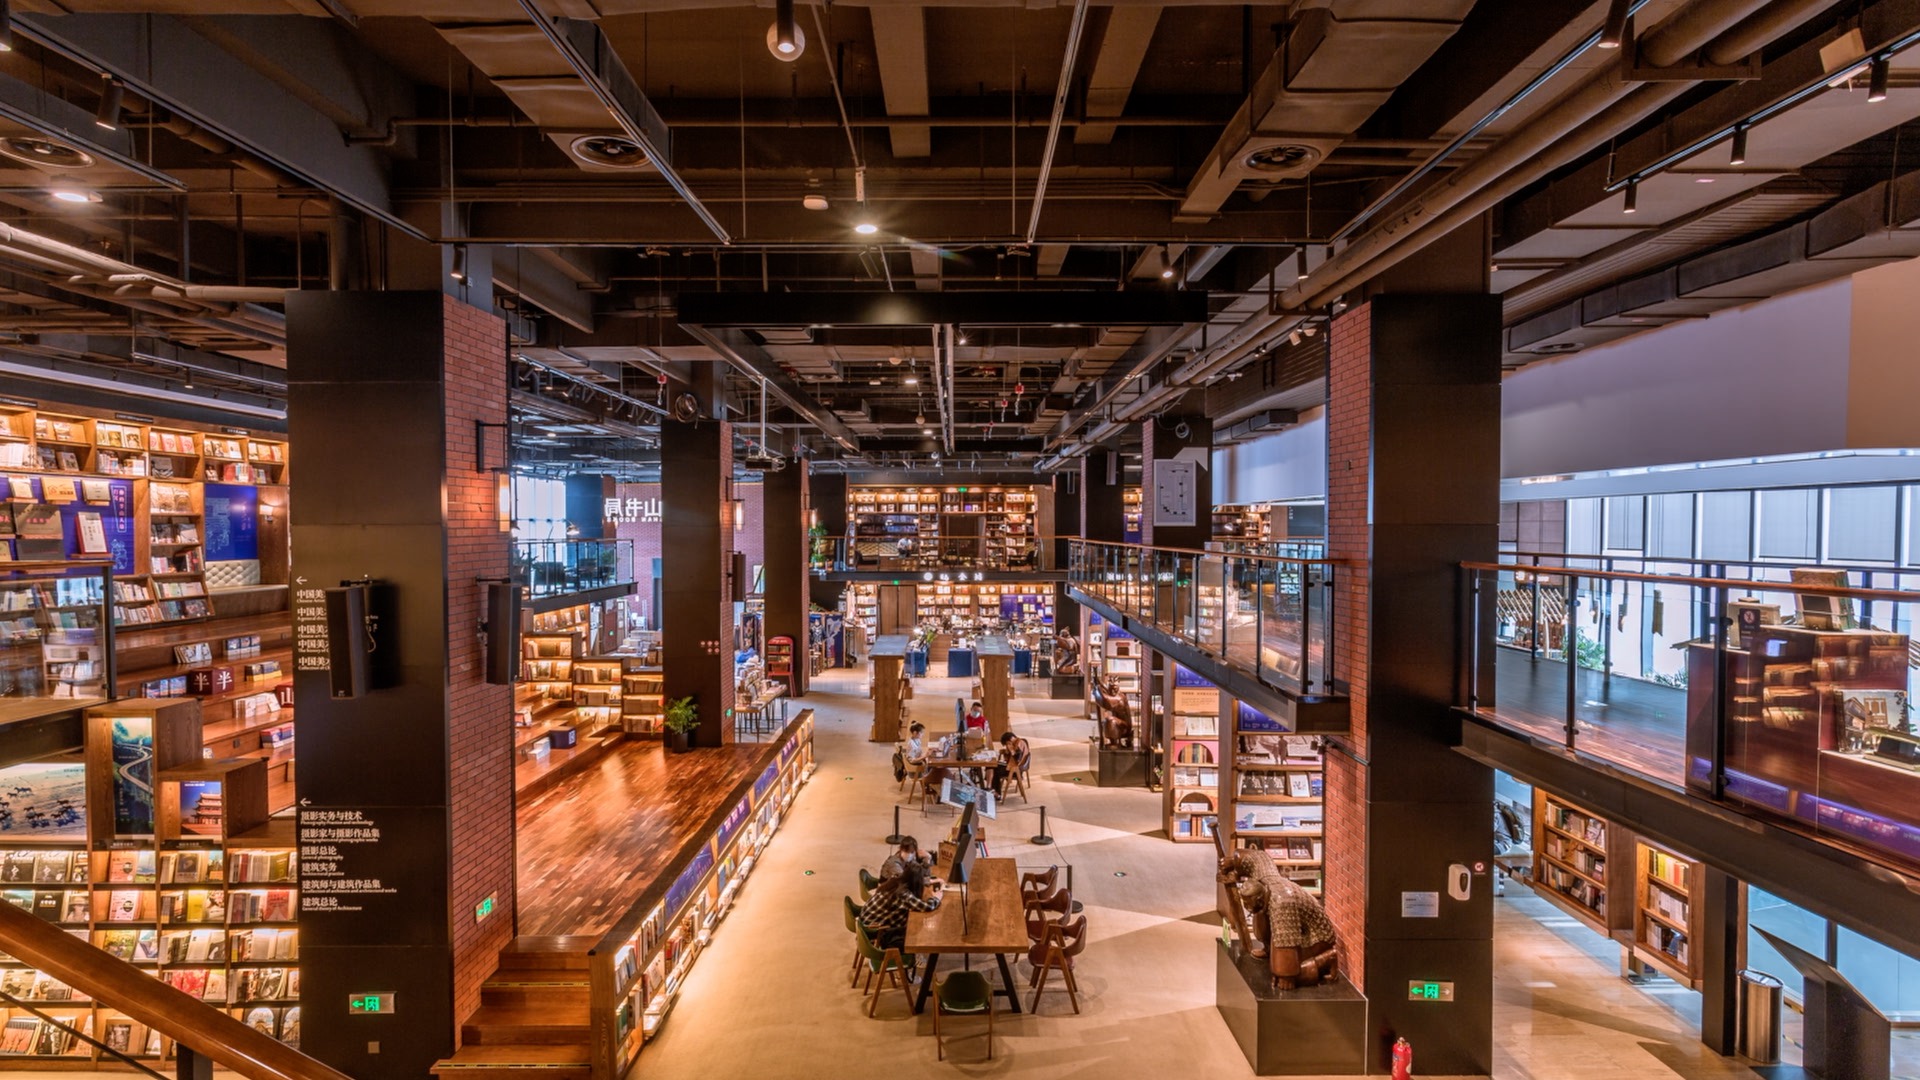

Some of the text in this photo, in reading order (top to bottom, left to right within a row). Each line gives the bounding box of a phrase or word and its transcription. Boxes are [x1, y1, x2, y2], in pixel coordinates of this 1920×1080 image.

[297, 589, 326, 599] 中国美
[193, 672, 210, 691] 半
[216, 671, 233, 690] 半
[280, 687, 294, 706] 山
[301, 811, 363, 821] 摄影实务与技术
[301, 828, 380, 838] 摄影家与摄影作品集
[301, 846, 338, 856] 摄影总论
[302, 862, 338, 872] 建筑实务
[302, 879, 381, 889] 建筑师与建筑作品集
[302, 897, 338, 907] 建筑总论
